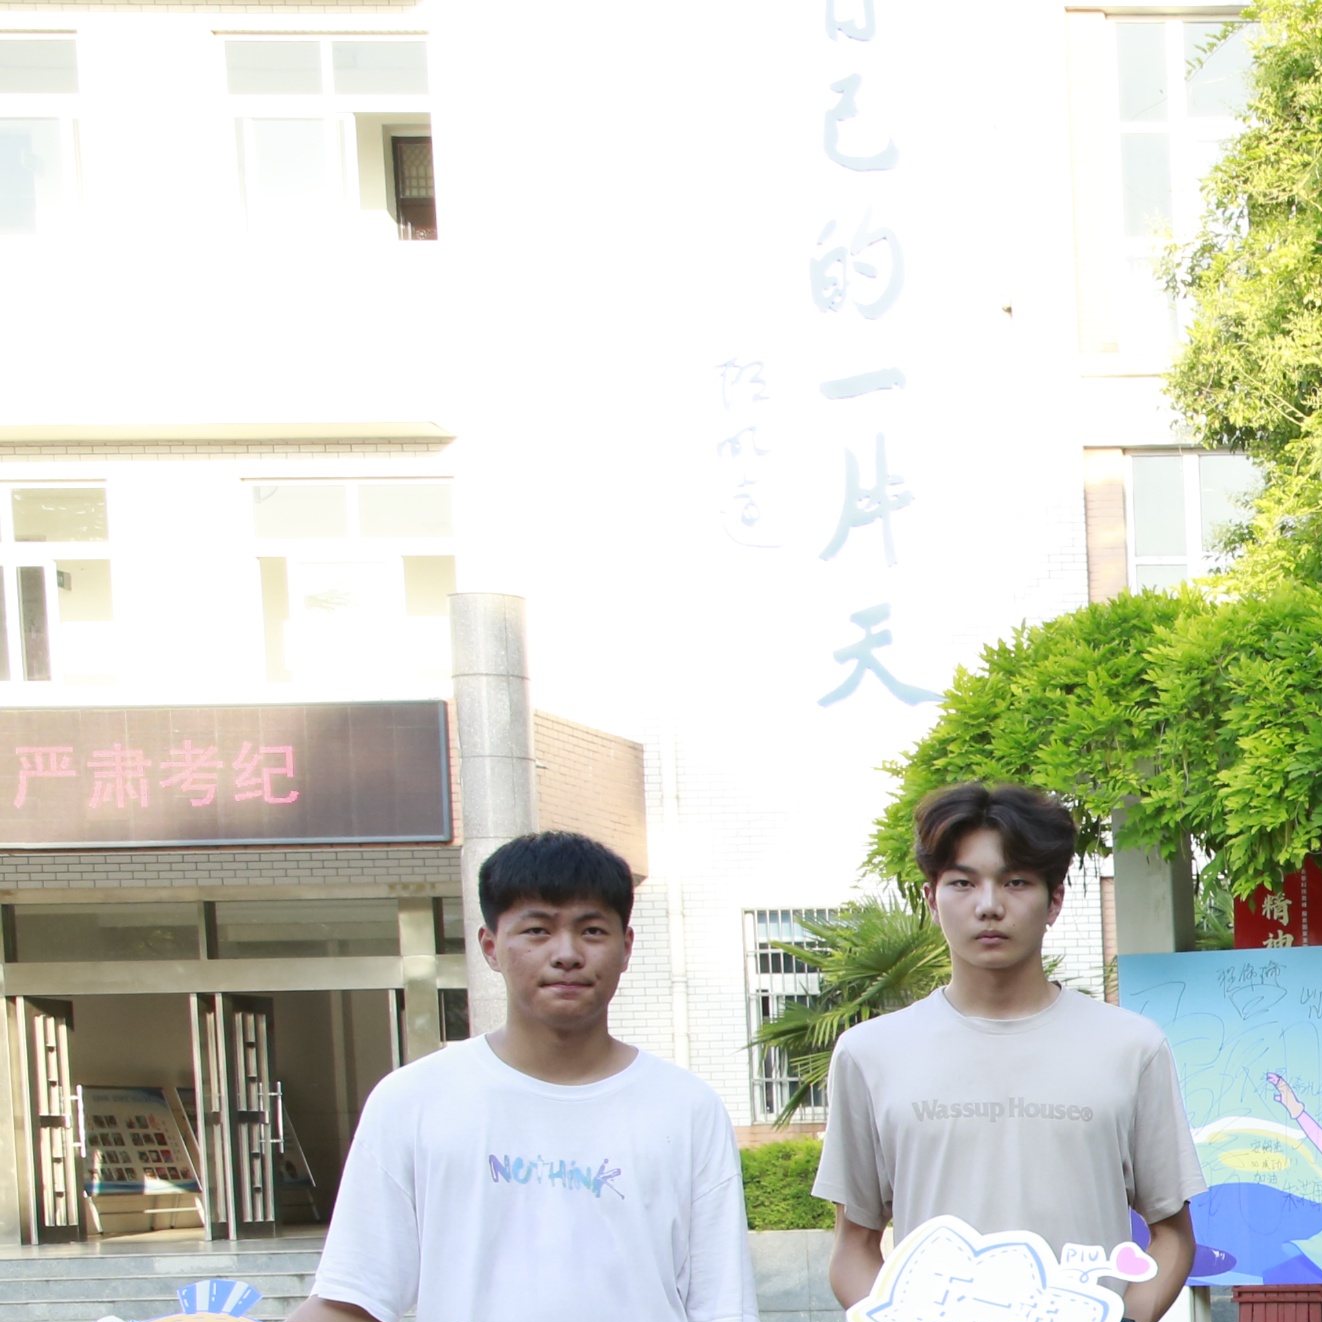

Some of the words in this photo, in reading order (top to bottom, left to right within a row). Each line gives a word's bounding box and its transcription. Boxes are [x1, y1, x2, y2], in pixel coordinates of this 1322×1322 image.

[13, 740, 299, 808] 严肃考纪
[911, 1099, 1005, 1123] Wassup
